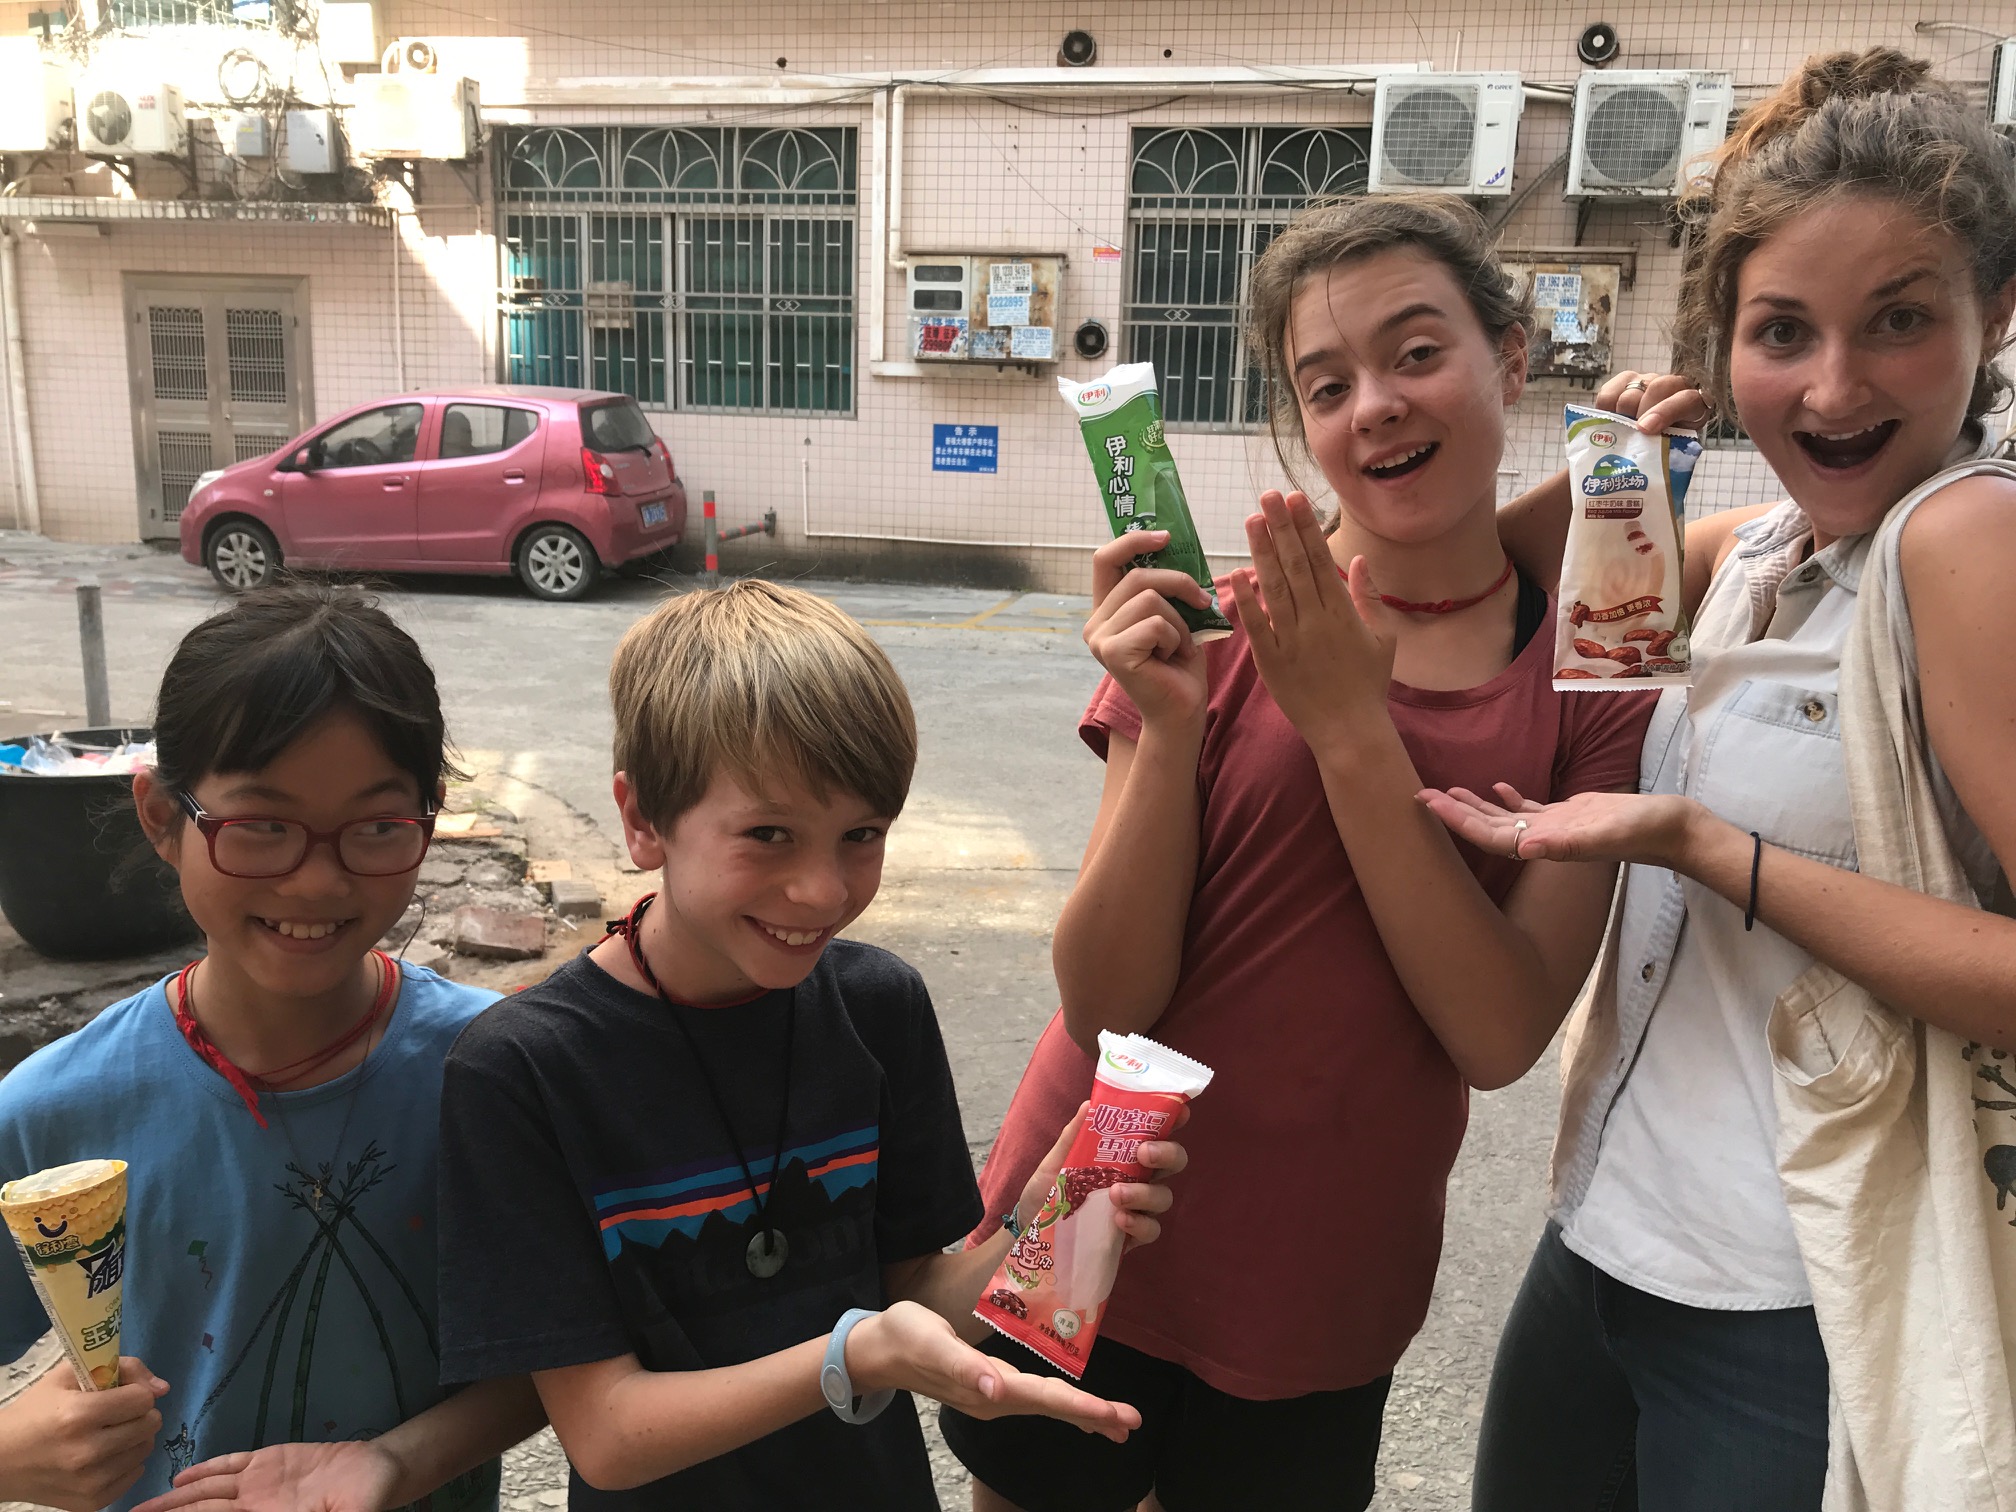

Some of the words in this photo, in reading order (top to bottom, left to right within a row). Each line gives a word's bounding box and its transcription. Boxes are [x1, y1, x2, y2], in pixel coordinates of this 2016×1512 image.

[1081, 388, 1106, 403] 伊利
[1593, 433, 1613, 444] 伊利
[1105, 435, 1136, 518] 伊利心情
[1584, 475, 1645, 493] 伊利牧场
